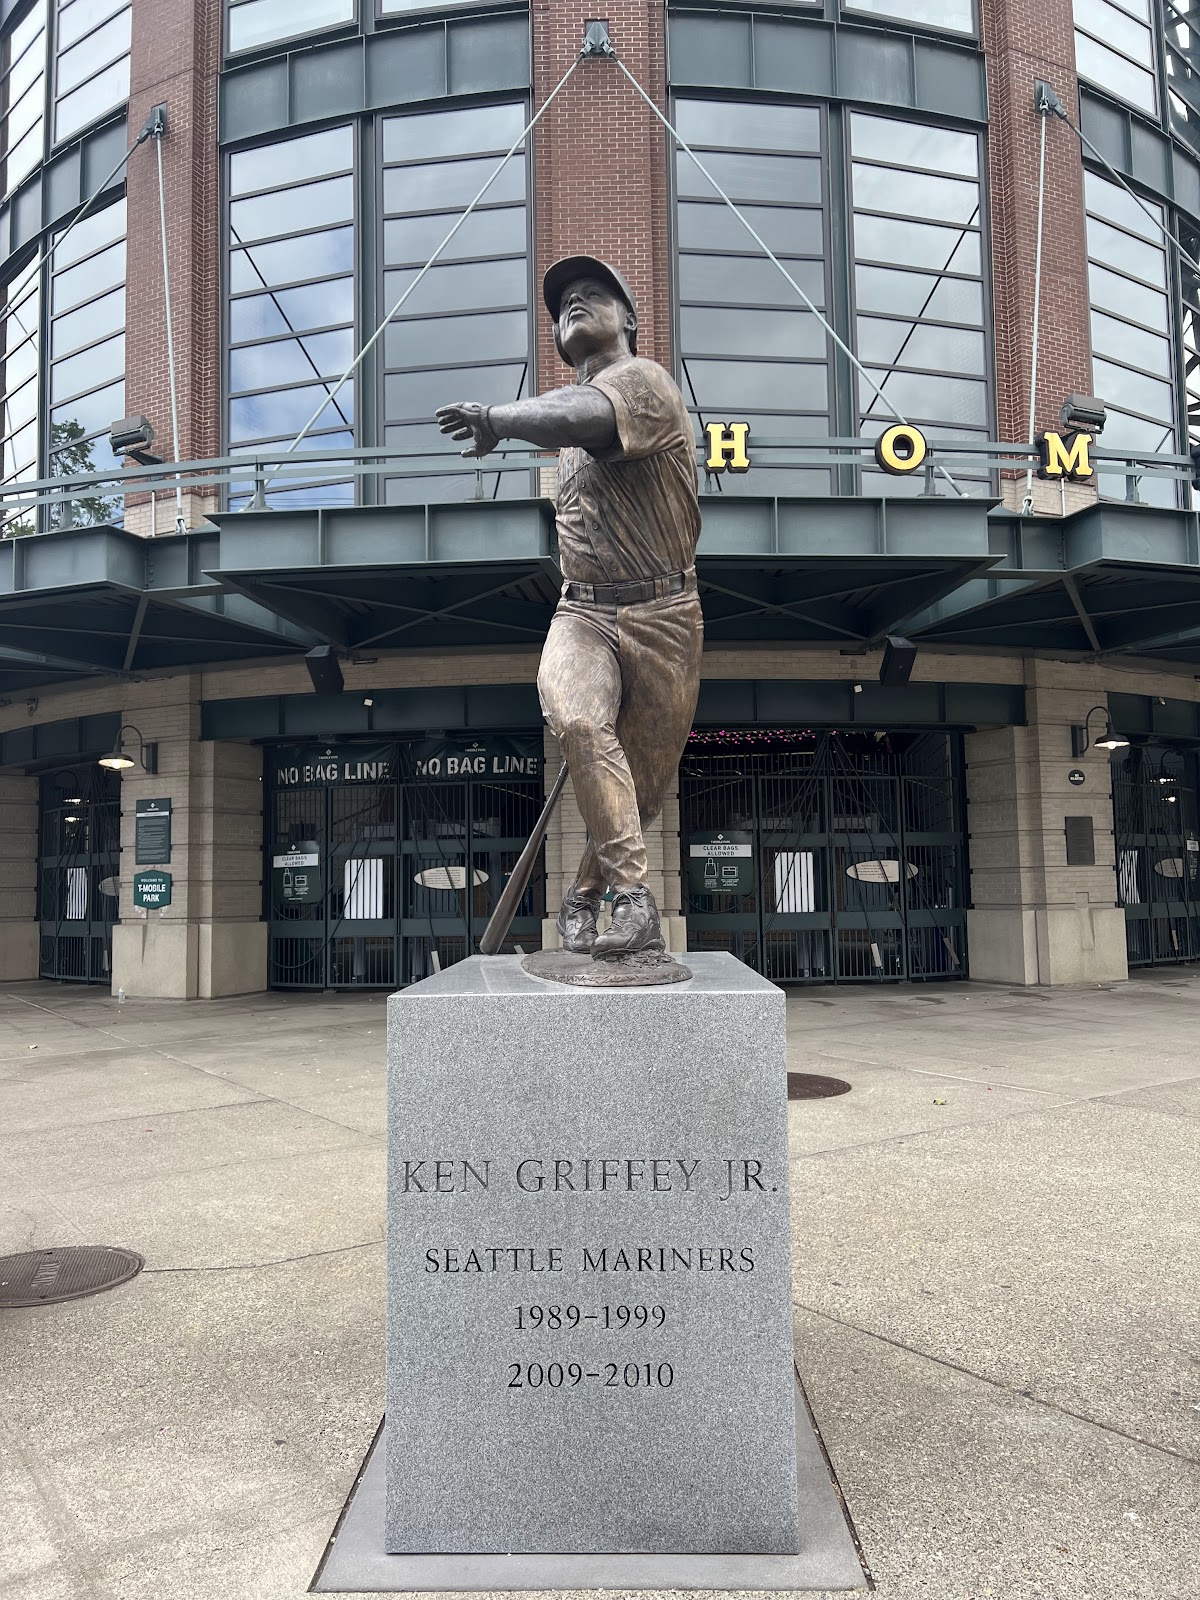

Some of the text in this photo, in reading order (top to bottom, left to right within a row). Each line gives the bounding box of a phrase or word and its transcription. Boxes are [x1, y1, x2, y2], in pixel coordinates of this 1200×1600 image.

[278, 762, 389, 785] NO BAG LINE
[415, 756, 538, 776] NO BAG LINE
[137, 884, 166, 893] T-MOBILE
[143, 893, 160, 902] PARK
[401, 1158, 778, 1201] KEN GRIFFEY JR.
[425, 1247, 755, 1273] SEATTLE MARINERS
